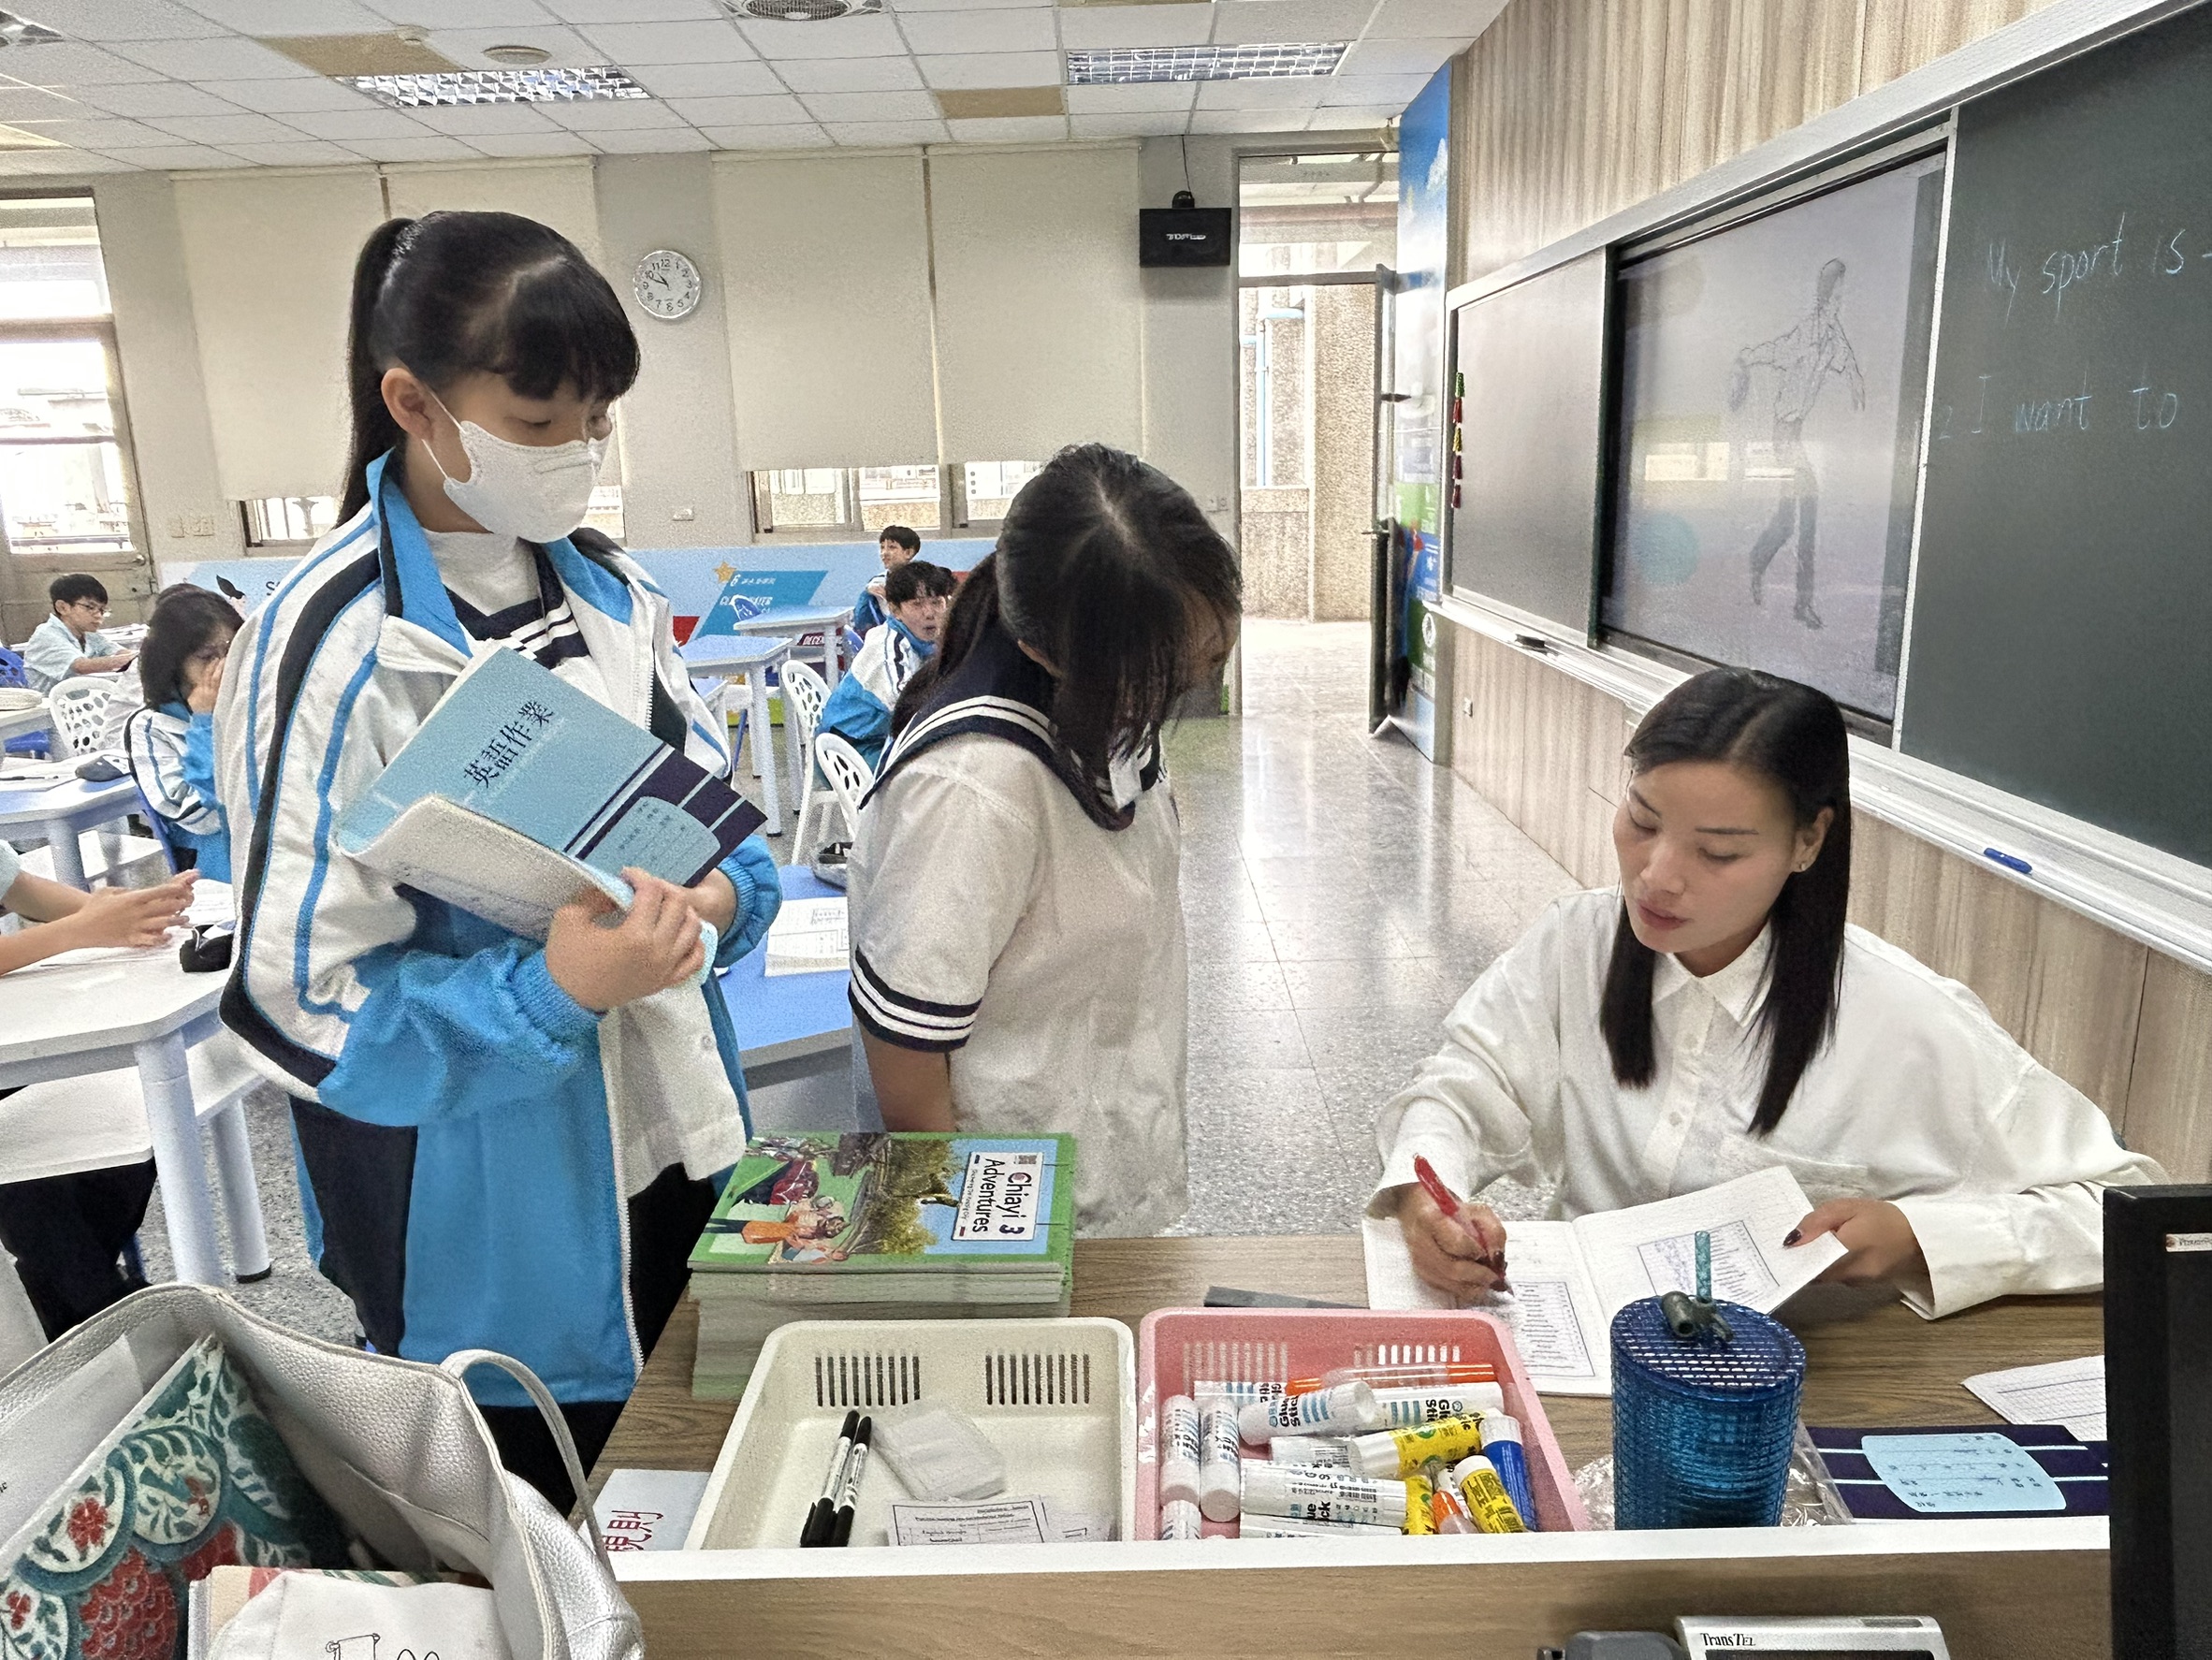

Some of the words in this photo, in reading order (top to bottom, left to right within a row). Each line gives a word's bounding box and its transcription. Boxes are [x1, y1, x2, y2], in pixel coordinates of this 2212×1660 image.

[661, 258, 671, 268] 12
[681, 269, 690, 278] 2
[1986, 237, 2021, 328] My
[2043, 212, 2126, 318] sport
[2152, 228, 2186, 274] is
[643, 282, 649, 290] 9
[685, 280, 693, 289] 3
[647, 292, 654, 301] 8
[656, 299, 662, 309] 7
[665, 302, 674, 312] 6
[677, 299, 684, 308] 5
[1971, 375, 1992, 434] I
[2015, 371, 2093, 432] want
[463, 701, 554, 789] 英語作業
[971, 1158, 1006, 1233] Adventures
[996, 1172, 1033, 1218] Chiayi
[998, 1224, 1026, 1235] 3
